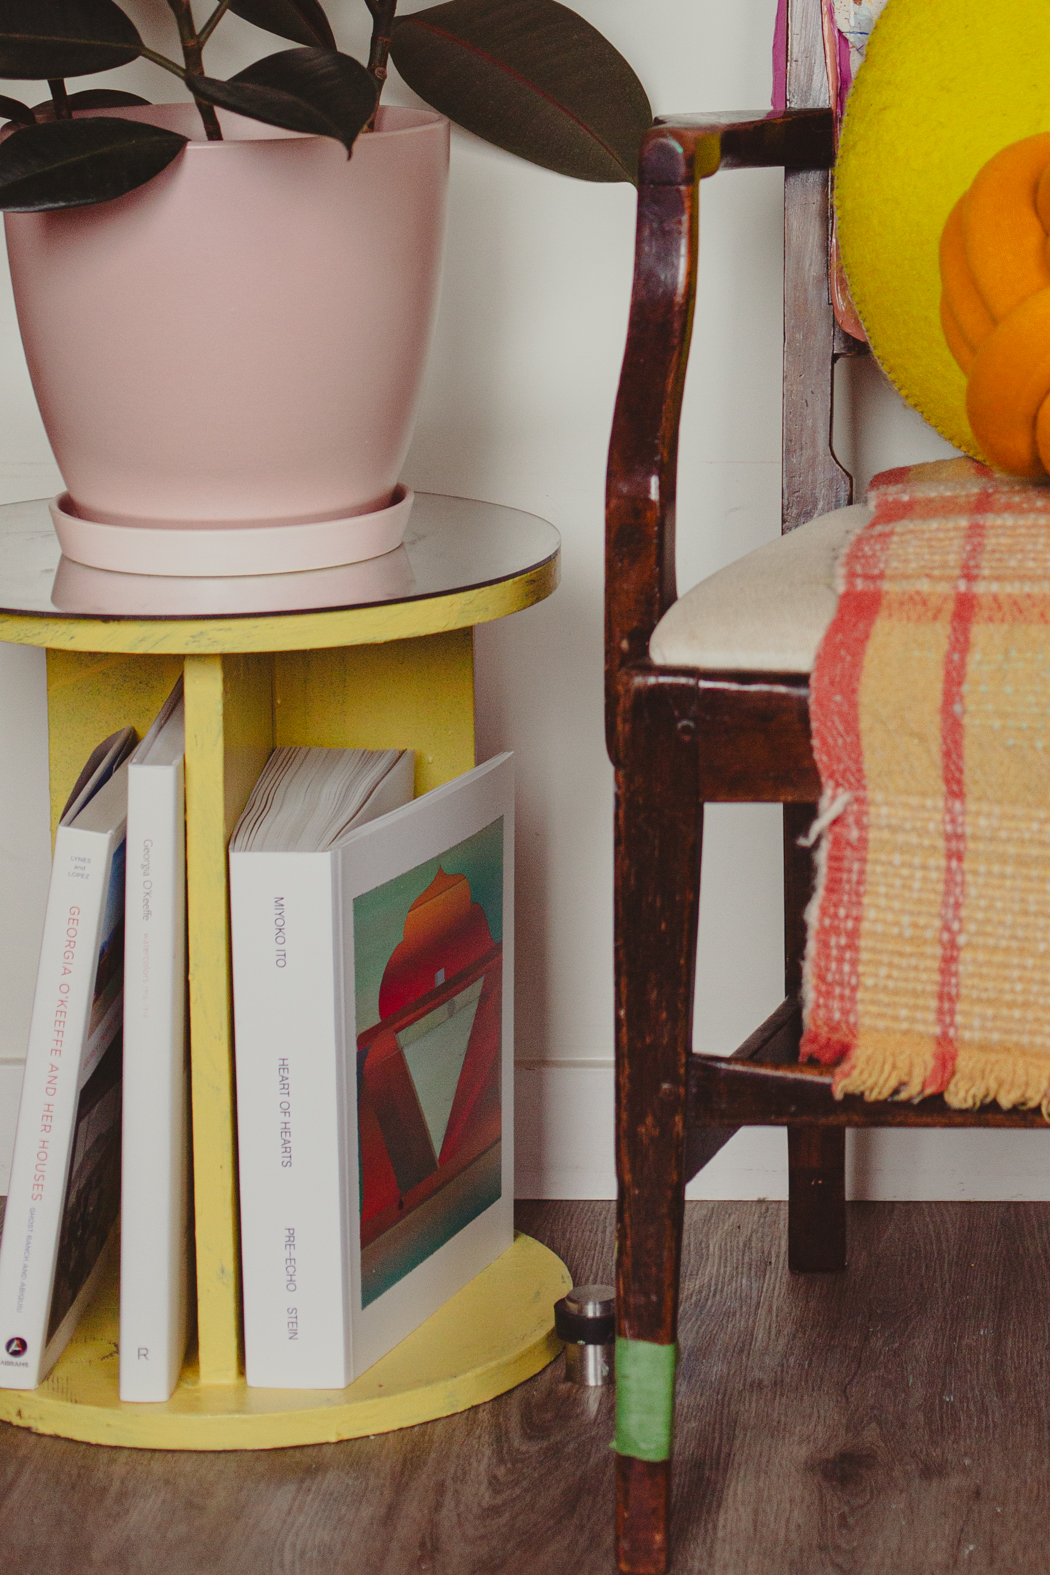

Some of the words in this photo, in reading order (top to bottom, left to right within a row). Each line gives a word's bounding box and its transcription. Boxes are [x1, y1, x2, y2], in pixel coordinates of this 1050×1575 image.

[71, 856, 91, 864] LYNES
[140, 839, 153, 876] Georgia
[142, 880, 152, 921] O'Keeffe
[274, 897, 286, 945] MIYOKO
[61, 906, 80, 976] GEORGIA
[276, 949, 286, 968] ITO
[50, 983, 70, 1058] O'KEEFFE
[45, 1063, 59, 1097] AND
[278, 1058, 290, 1097] HEART
[40, 1103, 54, 1133] HER
[279, 1101, 290, 1118] OF
[280, 1122, 292, 1168] HEARTS
[31, 1140, 49, 1202] HOUSES
[26, 1207, 35, 1232] GHOST
[24, 1235, 32, 1261] RANCH
[284, 1228, 297, 1292] PRE-ECHO
[287, 1308, 298, 1340] STEIN
[0, 1360, 29, 1368] ABRAMS
